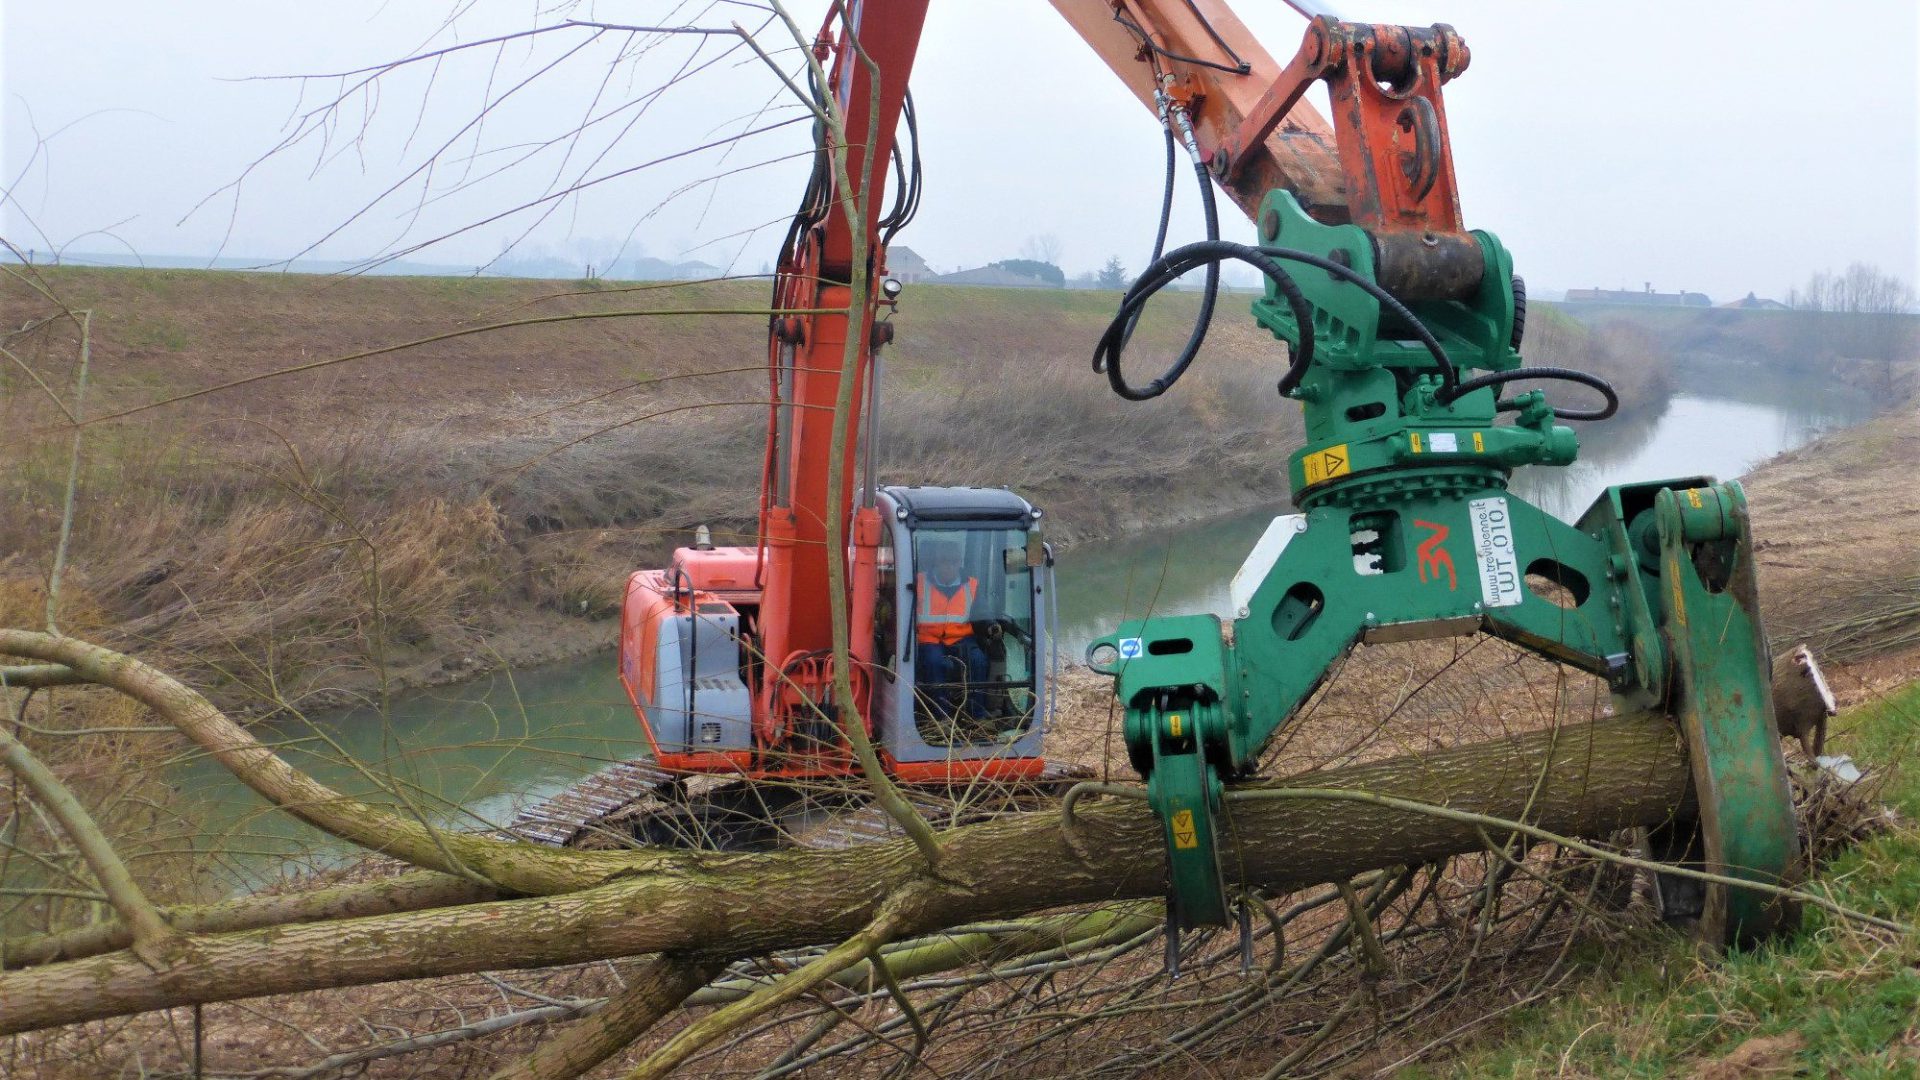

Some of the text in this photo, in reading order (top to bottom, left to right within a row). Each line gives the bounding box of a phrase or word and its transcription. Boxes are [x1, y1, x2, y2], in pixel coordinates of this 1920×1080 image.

[1476, 502, 1501, 603] www.trevibenne.it
[1488, 510, 1516, 593] WT 010
